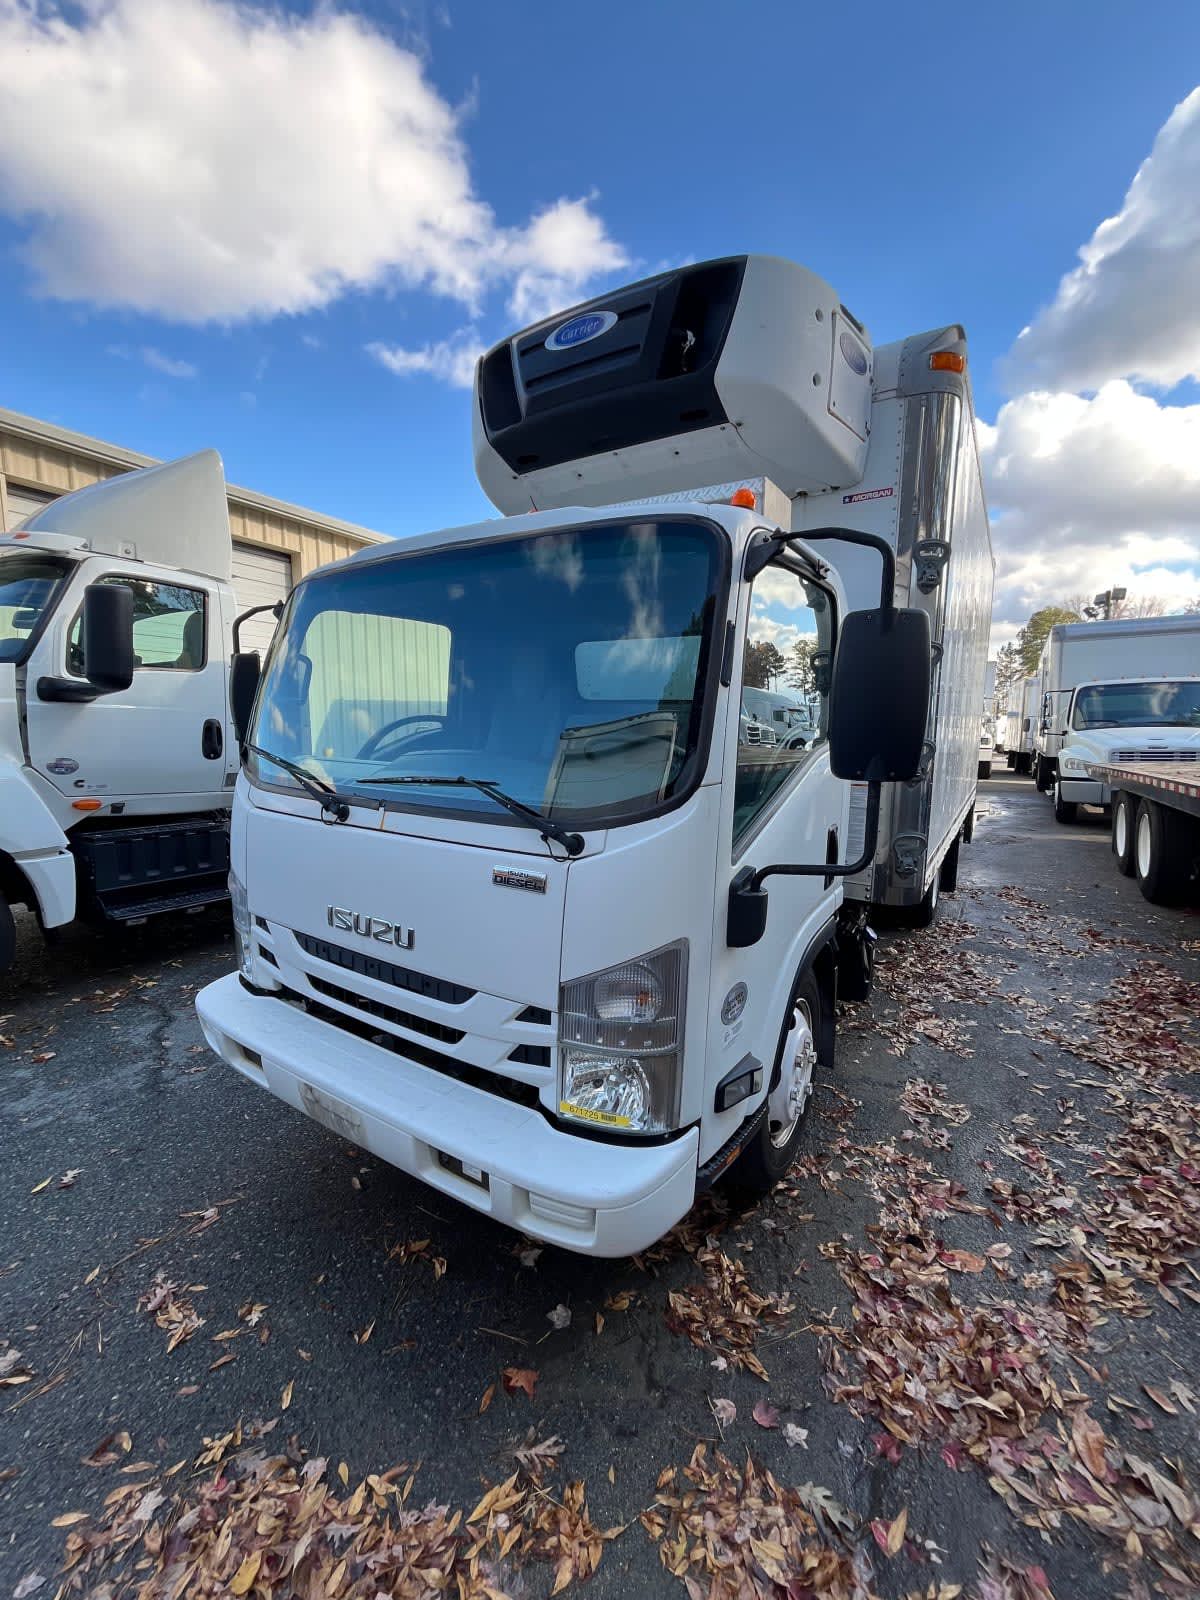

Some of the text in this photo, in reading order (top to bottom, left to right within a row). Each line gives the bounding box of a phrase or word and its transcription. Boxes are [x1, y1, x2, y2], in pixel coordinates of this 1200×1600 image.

[561, 319, 600, 341] Carrier
[852, 490, 892, 502] MORGAN
[507, 869, 529, 878] ISUZU
[495, 875, 543, 891] DIESEL
[327, 904, 415, 950] ISUZU
[569, 1106, 598, 1120] 671725
